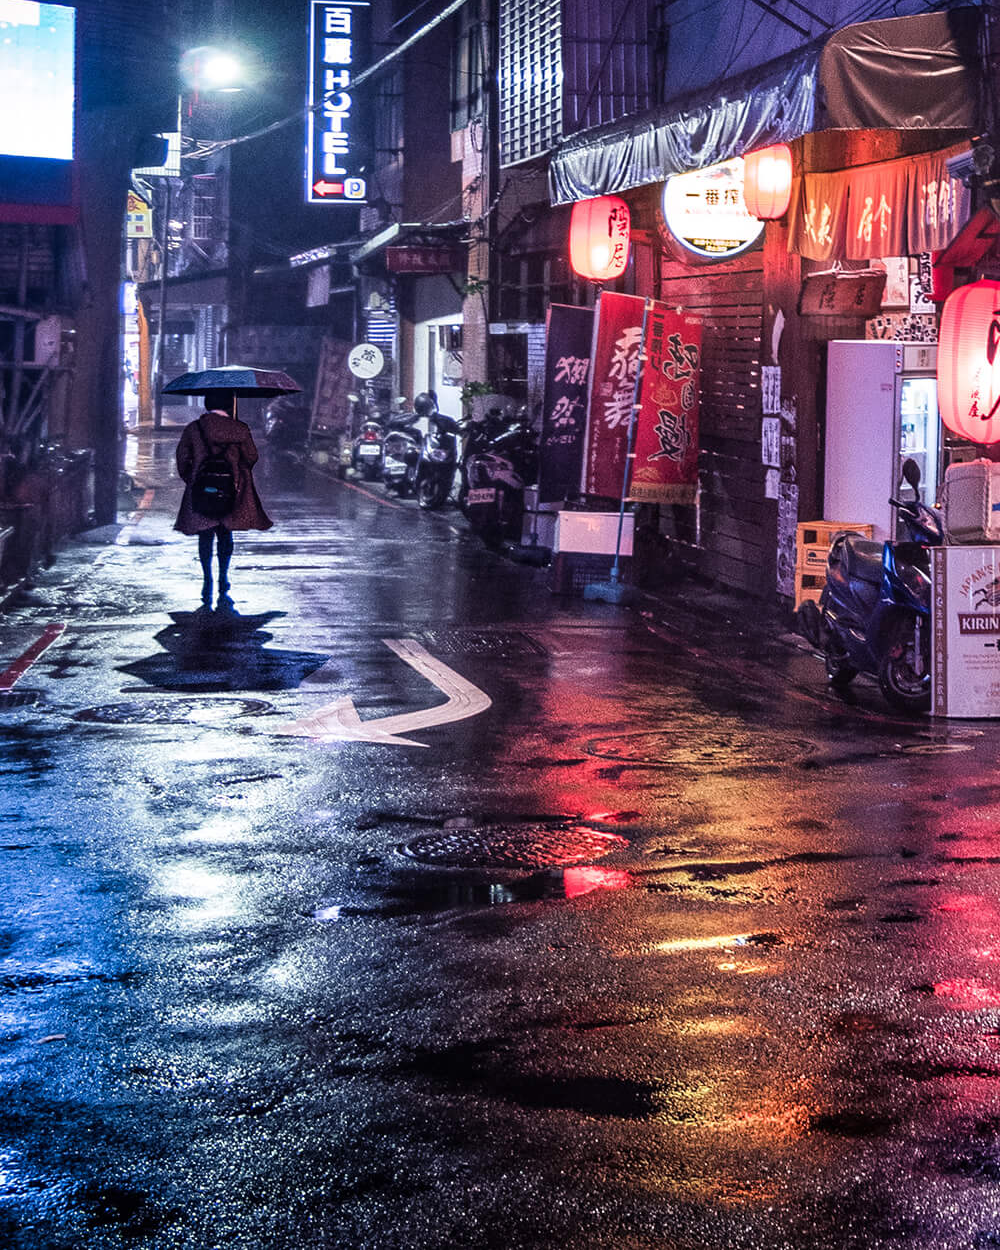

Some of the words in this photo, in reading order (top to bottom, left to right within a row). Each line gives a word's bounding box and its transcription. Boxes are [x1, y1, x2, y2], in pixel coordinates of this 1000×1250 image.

[323, 68, 353, 175] HOTEL
[960, 564, 994, 598] JAPAN'S
[961, 617, 999, 631] KIRIN
